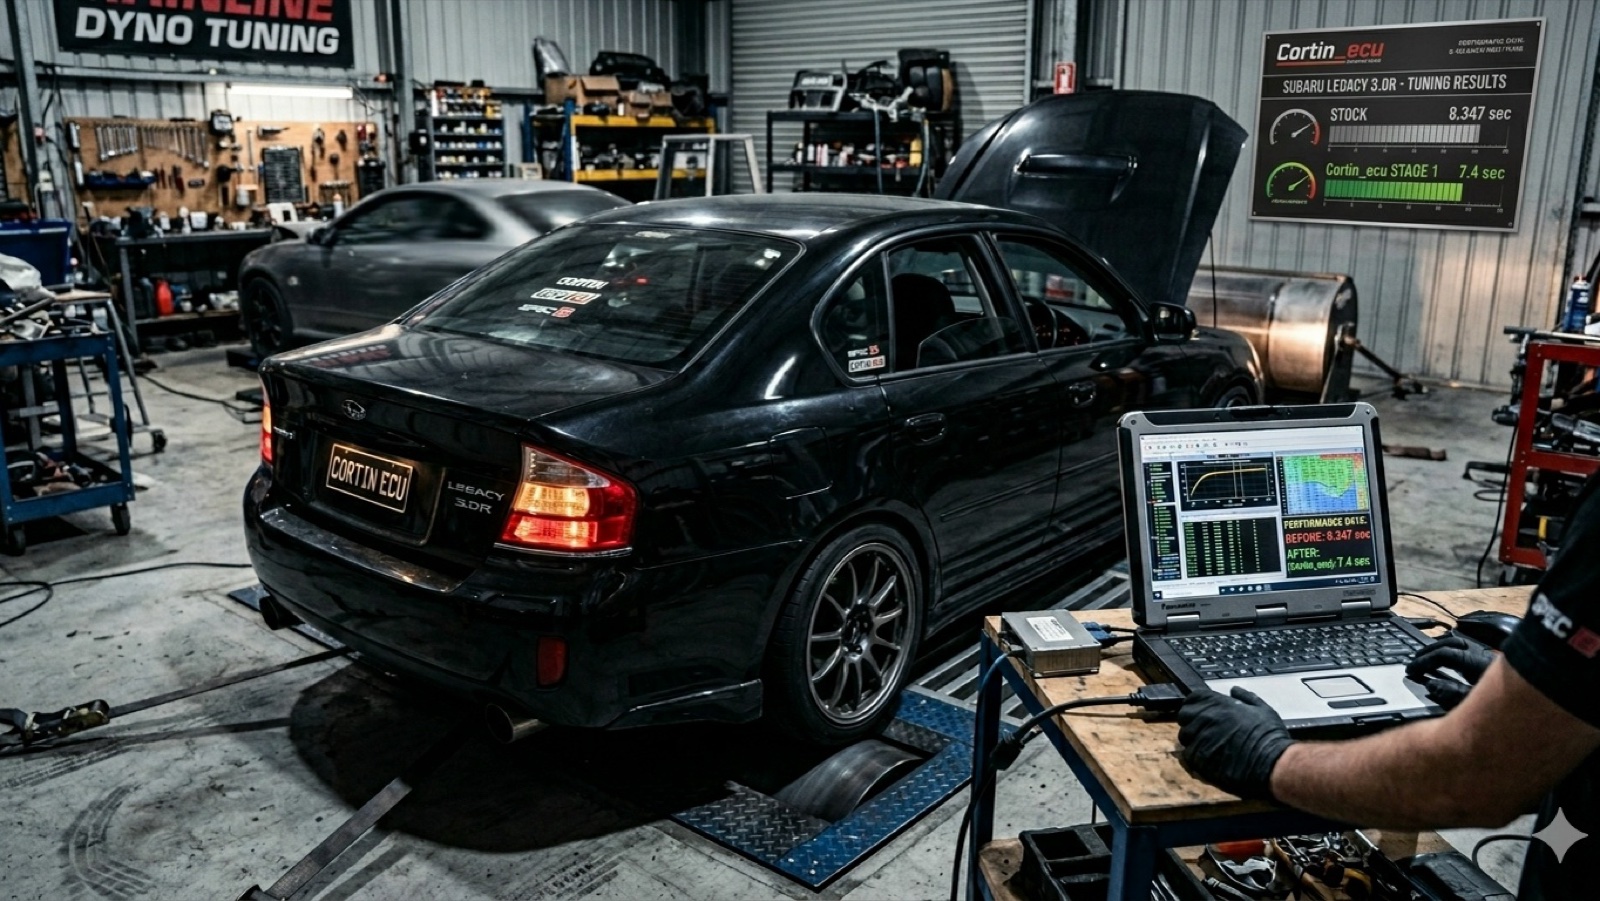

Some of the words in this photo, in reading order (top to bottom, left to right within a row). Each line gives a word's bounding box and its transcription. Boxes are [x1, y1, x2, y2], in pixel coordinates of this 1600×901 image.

[75, 7, 193, 45] DYNO
[205, 18, 340, 55] TUNING
[1276, 41, 1384, 61] Cortin_ecu
[1282, 79, 1325, 94] SUBARU
[1408, 75, 1451, 91] TUNING
[1453, 73, 1507, 90] RESULTS
[1330, 107, 1368, 121] STOCK
[1448, 106, 1486, 121] 8.347
[1488, 108, 1512, 120] sec
[1326, 162, 1388, 179] Cortin_ecu
[1432, 163, 1438, 178] 1
[1459, 164, 1479, 179] 7.4
[1482, 167, 1506, 180] sec
[331, 455, 379, 493] CORTIN
[378, 470, 408, 501] ECU
